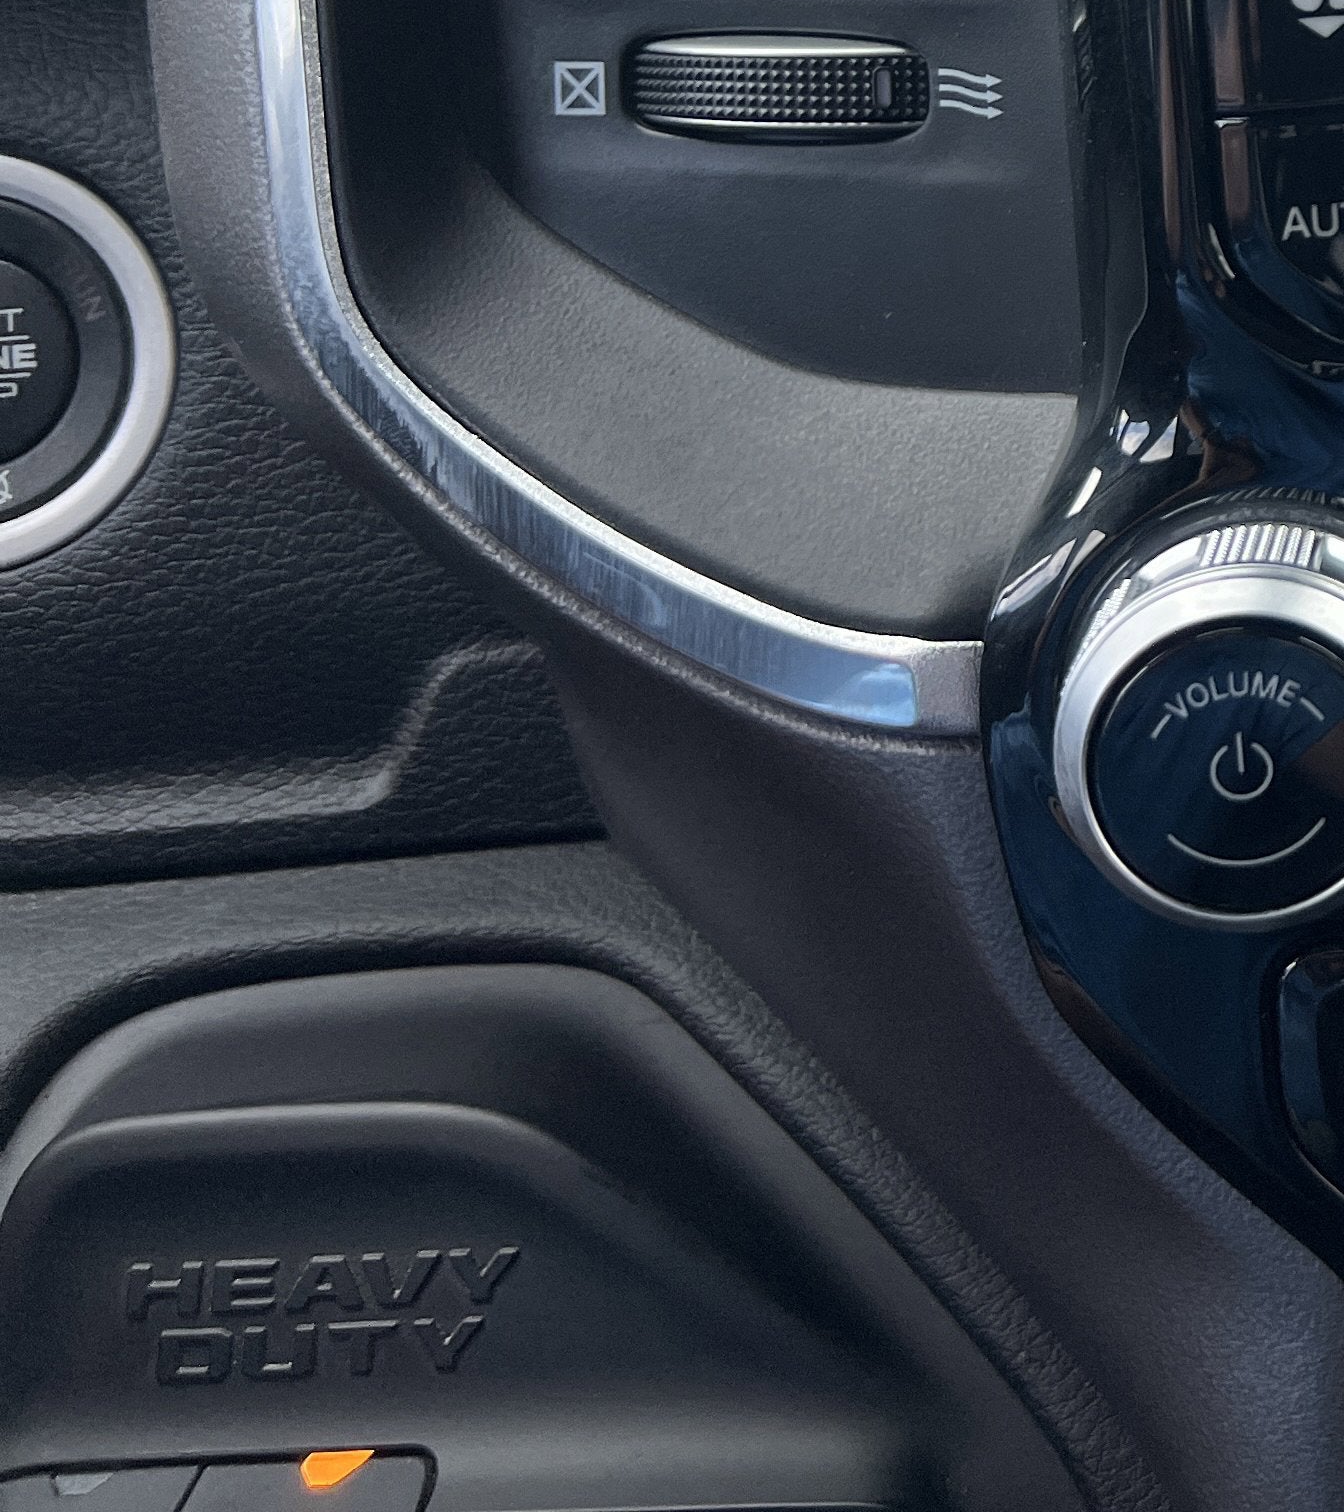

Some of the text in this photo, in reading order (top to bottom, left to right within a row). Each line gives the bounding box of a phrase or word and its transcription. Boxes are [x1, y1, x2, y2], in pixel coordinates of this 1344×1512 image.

[1162, 670, 1304, 720] VOLUME
[126, 1246, 519, 1320] HEAVY
[156, 1314, 485, 1385] DUTY
